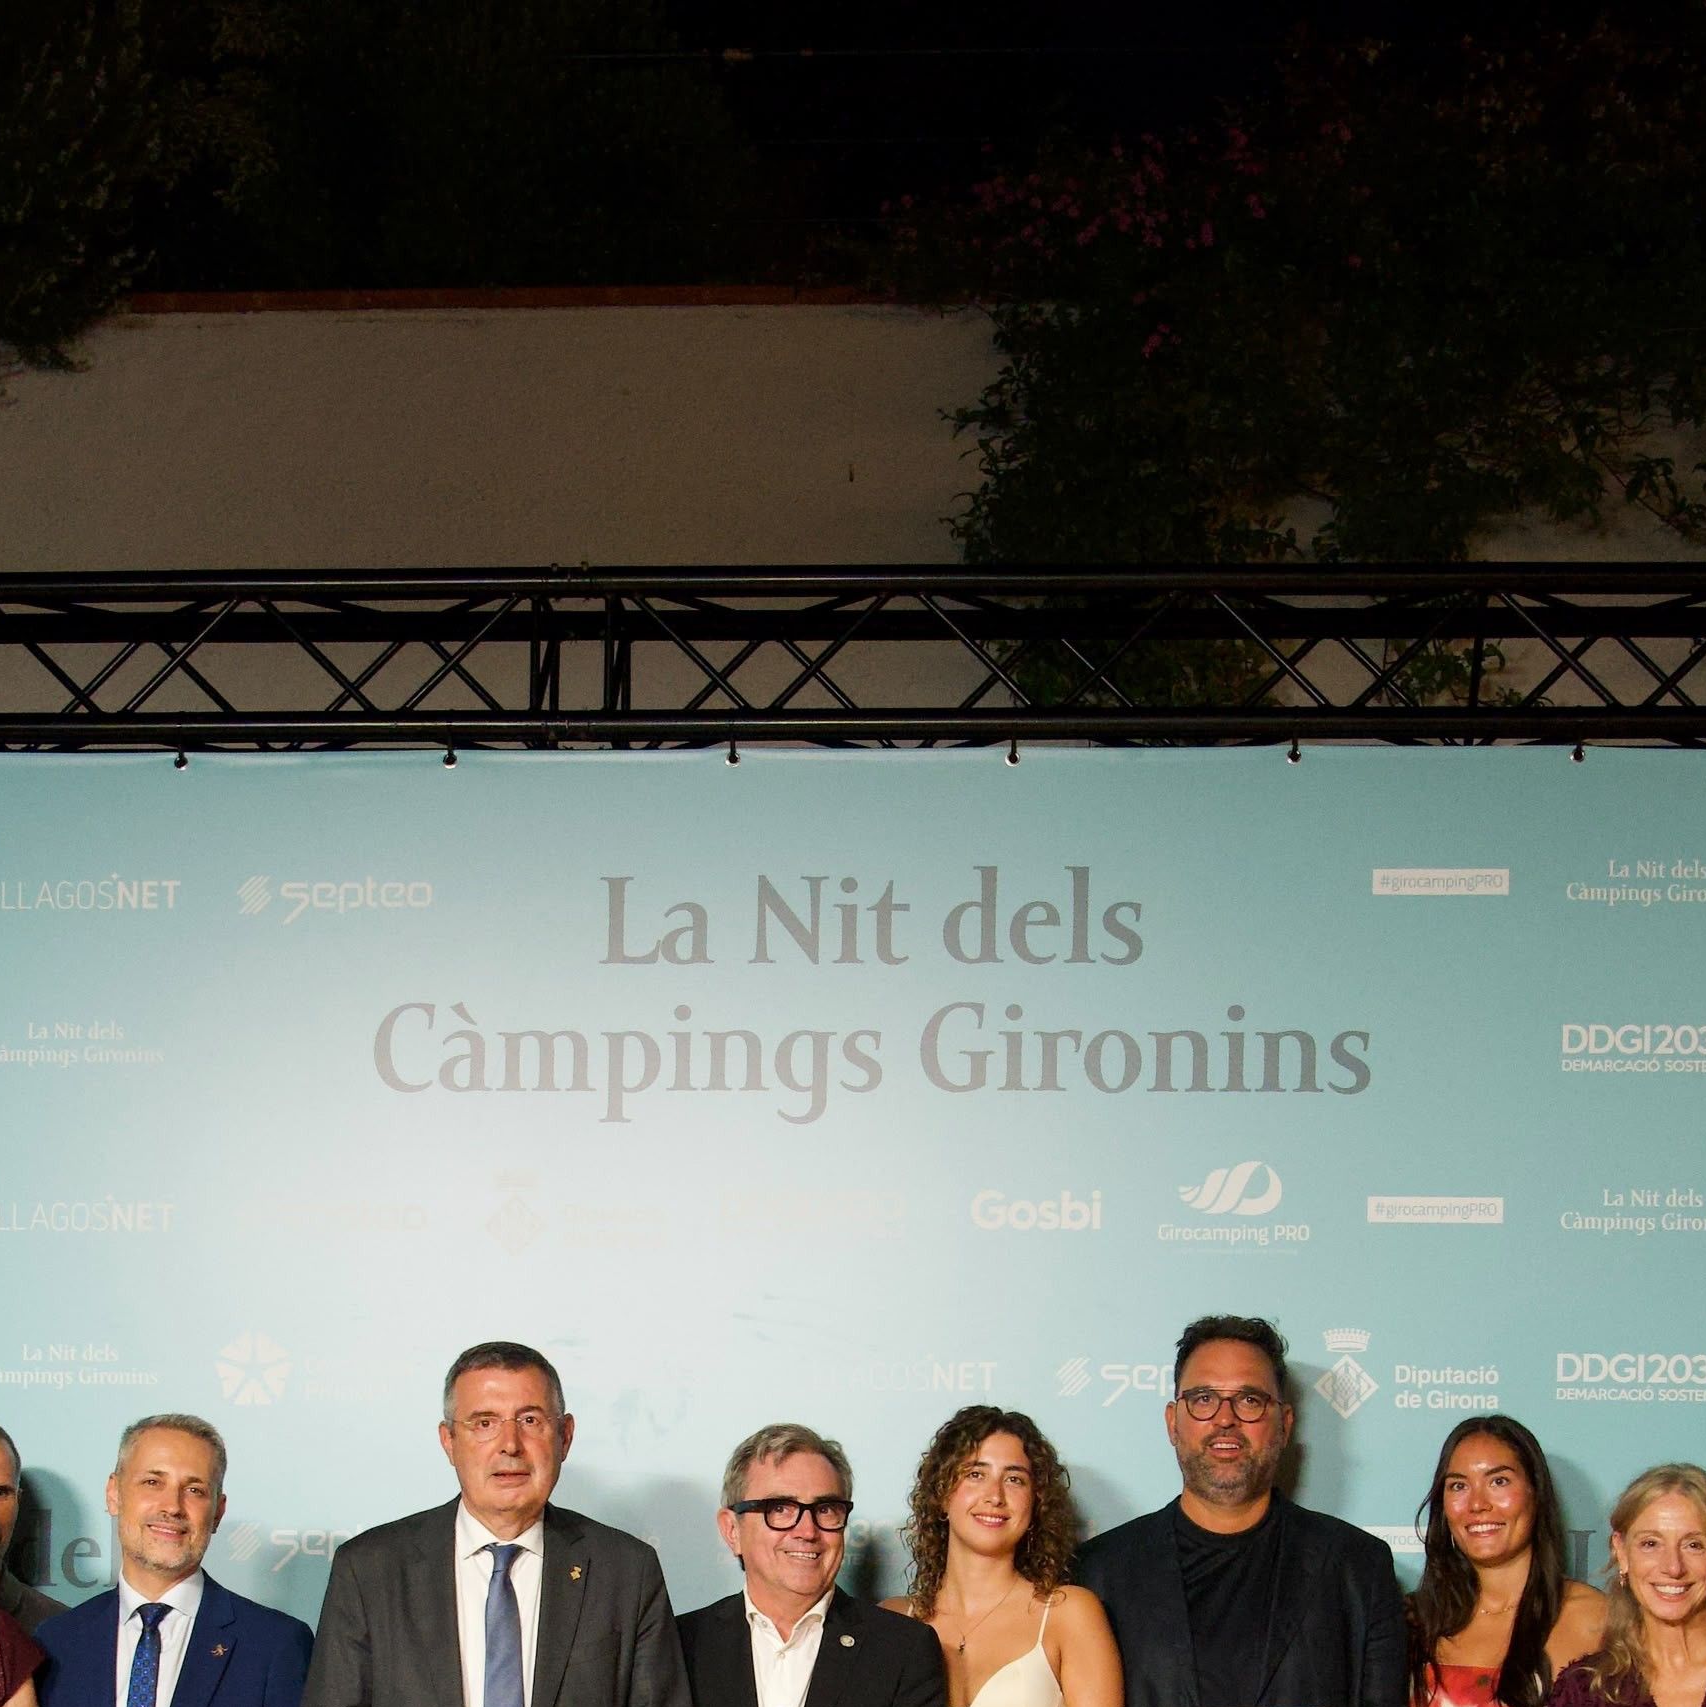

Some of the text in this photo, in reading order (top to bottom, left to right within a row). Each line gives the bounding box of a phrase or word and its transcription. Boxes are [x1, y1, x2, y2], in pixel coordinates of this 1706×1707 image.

[1608, 860, 1631, 879] La
[1636, 860, 1667, 879] Nit
[1380, 874, 1503, 893] #girocampingPRO
[281, 876, 433, 924] septeo
[1566, 882, 1662, 907] Càmpings
[599, 864, 1145, 966] La Nit dels
[28, 1020, 125, 1040] La Nit dels
[84, 1045, 165, 1064] Gironins
[372, 1000, 1372, 1124] Càmpings Gironins
[1561, 1057, 1660, 1073] DEMARCACIÓ
[1602, 1188, 1704, 1208] La Nit dels
[971, 1189, 1101, 1231] Gosbi
[1375, 1201, 1498, 1220] #girocampingPRO
[1560, 1211, 1657, 1235] Càmpings
[1158, 1224, 1310, 1246] Girocamping PRO
[22, 1343, 119, 1362] La Nit dels
[78, 1367, 158, 1386] Gironins
[1395, 1365, 1499, 1387] Diputació
[1395, 1390, 1499, 1410] de Girona
[1557, 1387, 1654, 1401] DEMARCACIÓ
